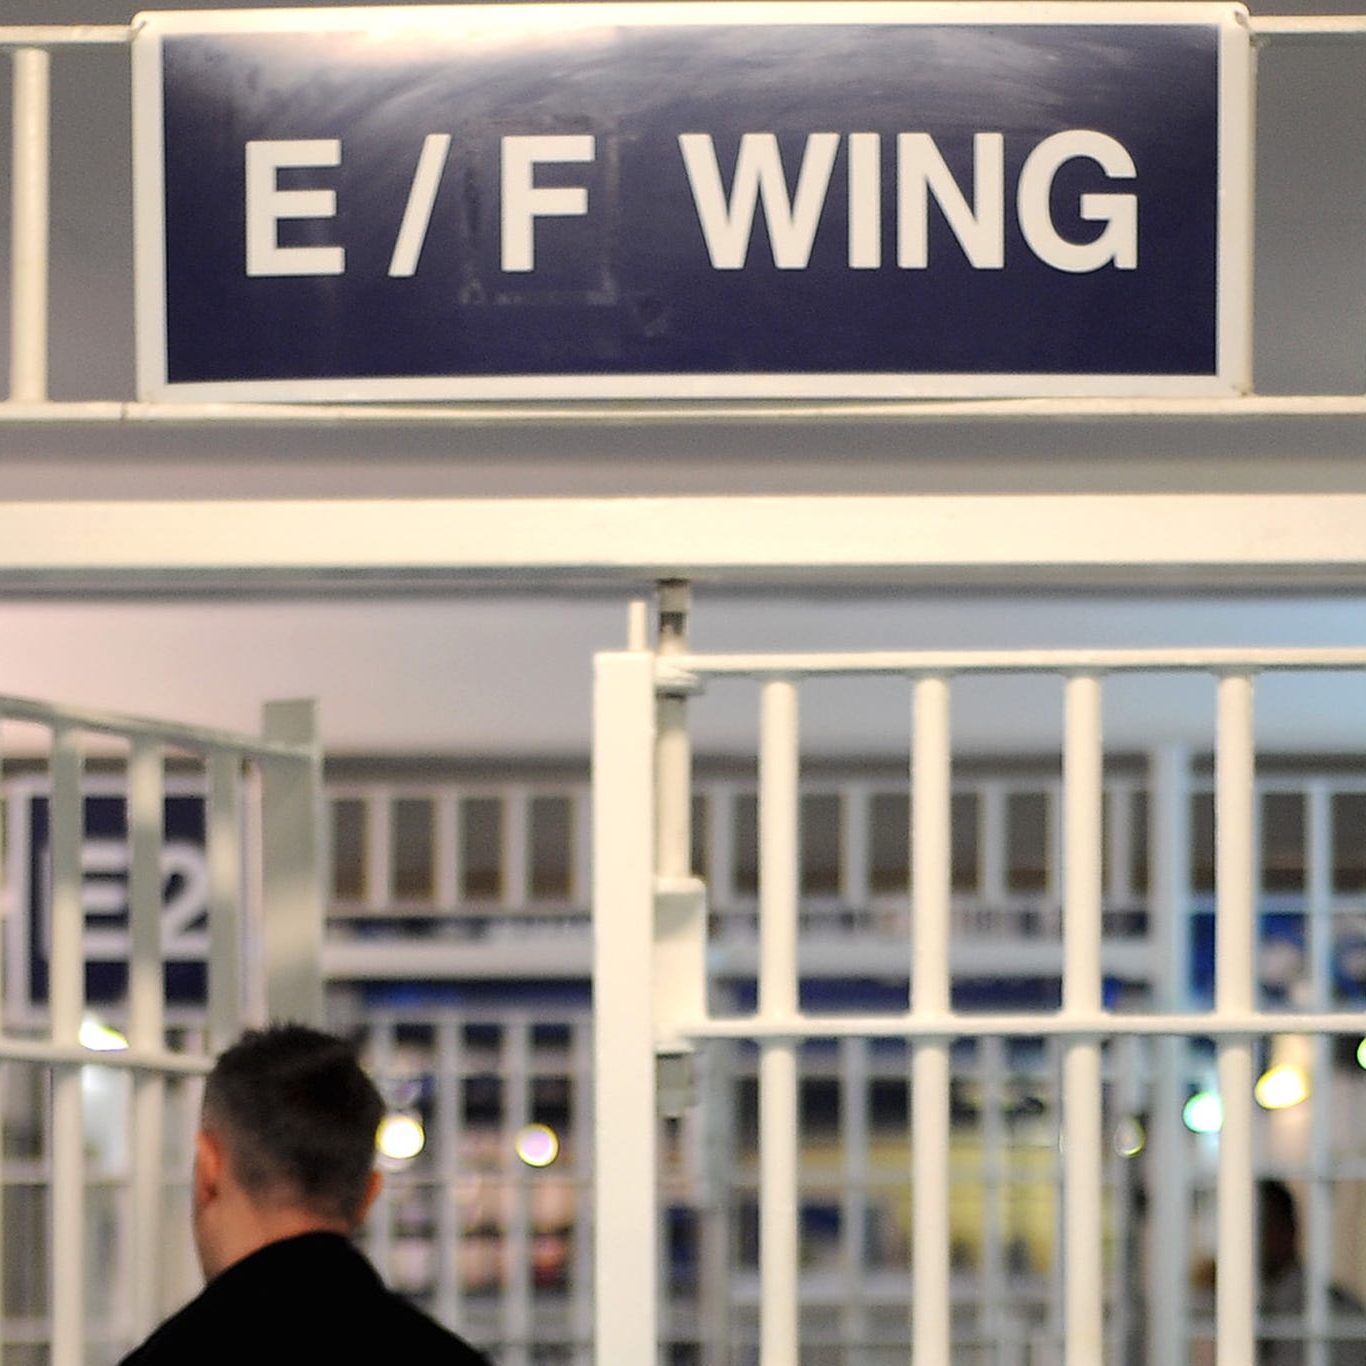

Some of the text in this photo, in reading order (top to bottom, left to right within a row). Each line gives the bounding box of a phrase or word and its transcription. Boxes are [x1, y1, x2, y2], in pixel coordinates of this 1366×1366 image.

[244, 129, 1139, 277] E / F WING
